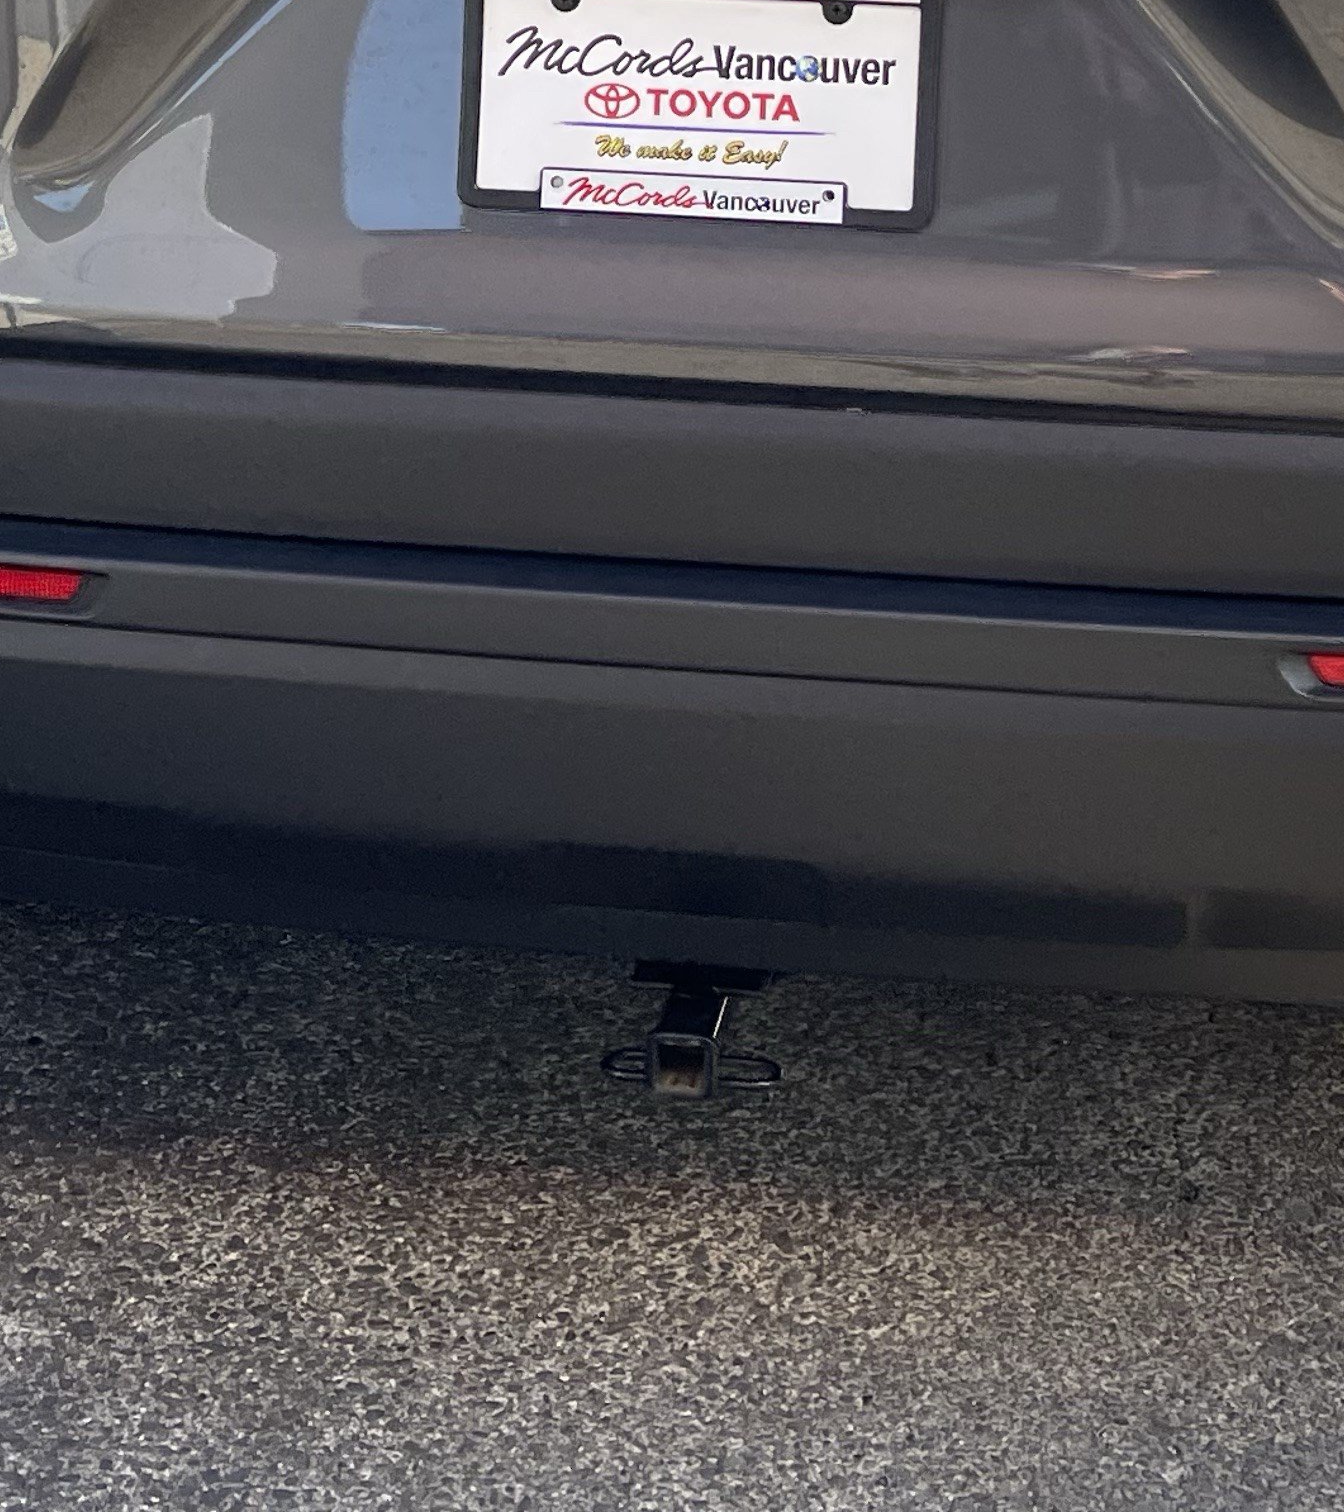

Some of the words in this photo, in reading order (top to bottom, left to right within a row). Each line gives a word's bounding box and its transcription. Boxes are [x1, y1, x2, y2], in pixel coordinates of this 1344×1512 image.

[497, 25, 708, 78] McCords
[712, 43, 897, 86] Vancouver
[646, 87, 801, 123] TOYOTA
[594, 134, 631, 158] We
[635, 137, 693, 162] make
[697, 142, 717, 162] it
[722, 139, 790, 170] Easy!
[562, 176, 704, 209] McCords
[702, 189, 821, 216] Vancouver
